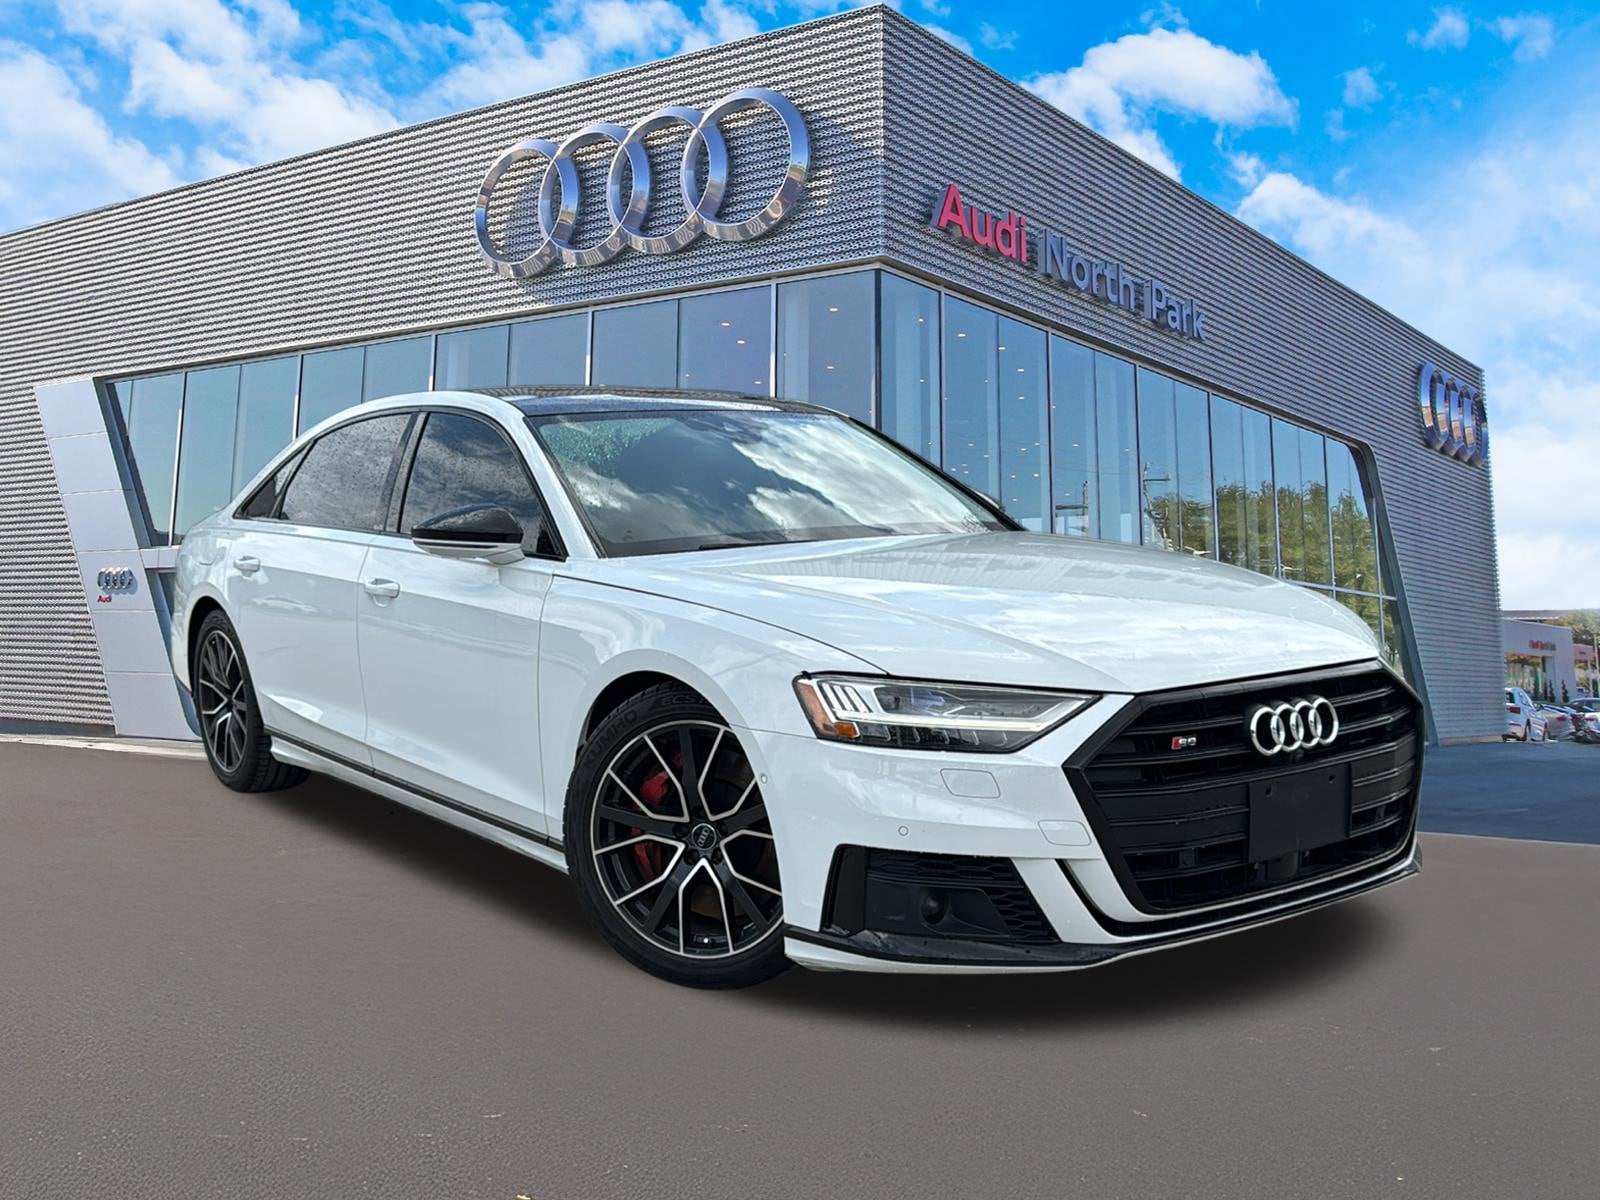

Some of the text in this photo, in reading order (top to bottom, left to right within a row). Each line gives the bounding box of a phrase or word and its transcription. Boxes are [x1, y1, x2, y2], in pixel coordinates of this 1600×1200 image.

[934, 183, 1207, 340] Audi North Park
[583, 710, 639, 768] KUMHO
